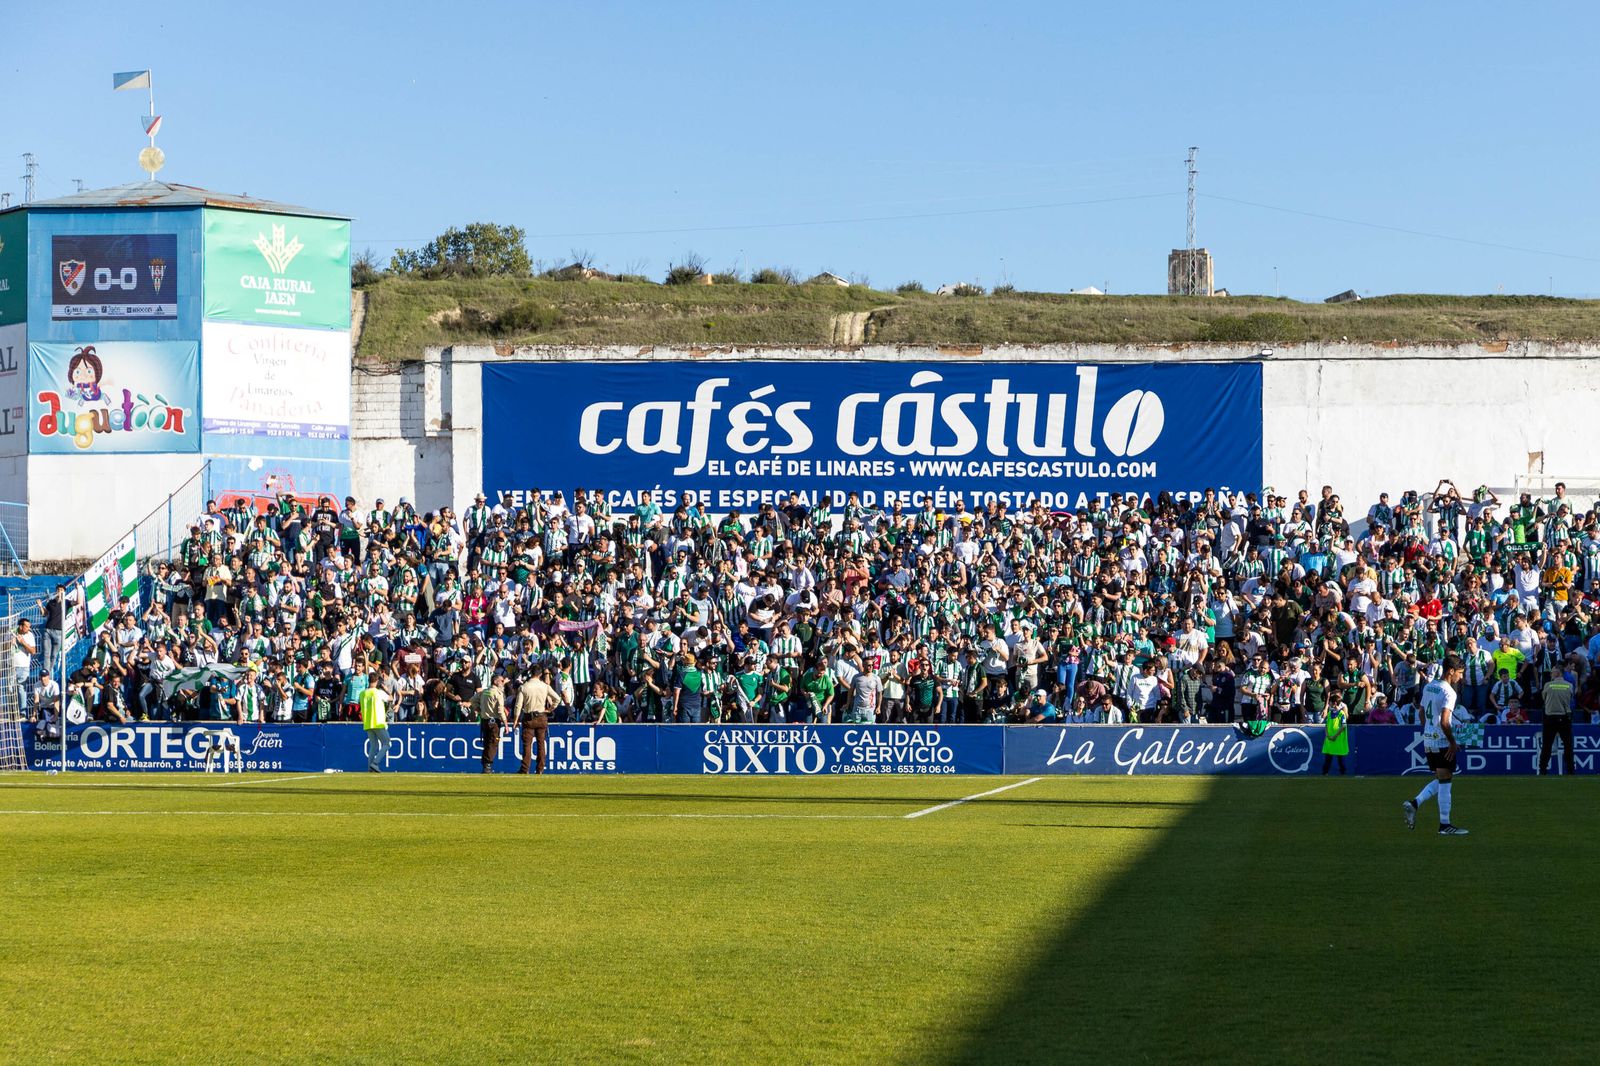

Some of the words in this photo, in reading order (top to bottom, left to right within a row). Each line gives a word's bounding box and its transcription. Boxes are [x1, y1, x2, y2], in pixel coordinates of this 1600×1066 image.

[94, 267, 137, 290] 0-0
[240, 275, 270, 290] CAJA
[273, 278, 315, 294] RURAL
[264, 370, 276, 381] de
[578, 377, 814, 476] cafés
[708, 460, 731, 475] EL
[735, 456, 782, 475] CAFÉ
[787, 460, 811, 475] DE
[816, 460, 895, 476] LINARES
[909, 461, 1157, 478] WWW.CAFESCASTULO.COM
[497, 490, 566, 507] VETA
[681, 490, 712, 507] DE
[719, 490, 877, 508] ESPECALDD
[971, 491, 1068, 508] TOSTADO
[1075, 491, 1088, 509] A
[1096, 491, 1151, 508] TDA
[1167, 486, 1249, 508] SPÑA
[1426, 700, 1434, 726] 4
[704, 726, 822, 744] CARNICERÍA
[844, 730, 941, 746] CALIDAD
[703, 744, 826, 774] SIXTO
[831, 747, 845, 762] Y
[852, 747, 954, 763] SERVICIO
[1047, 729, 1096, 765] La
[1114, 728, 1248, 775] Galería
[34, 759, 43, 767] C/
[46, 759, 76, 767] Fuete
[77, 759, 103, 769] Ayala,
[106, 760, 111, 768] 6
[119, 760, 128, 768] C/
[131, 759, 173, 769] Mazarrón,
[176, 761, 181, 769] 8
[189, 760, 221, 769] Linaes
[246, 761, 257, 769] 60
[259, 761, 270, 769] 26
[272, 761, 282, 769] 91
[543, 761, 616, 770] INARES
[831, 765, 842, 774] C/
[844, 763, 879, 774] BAÑOS,
[880, 765, 892, 773] 38
[898, 765, 914, 774] 653
[916, 765, 927, 774] 78
[929, 765, 941, 774] 06
[943, 765, 956, 774] 04
